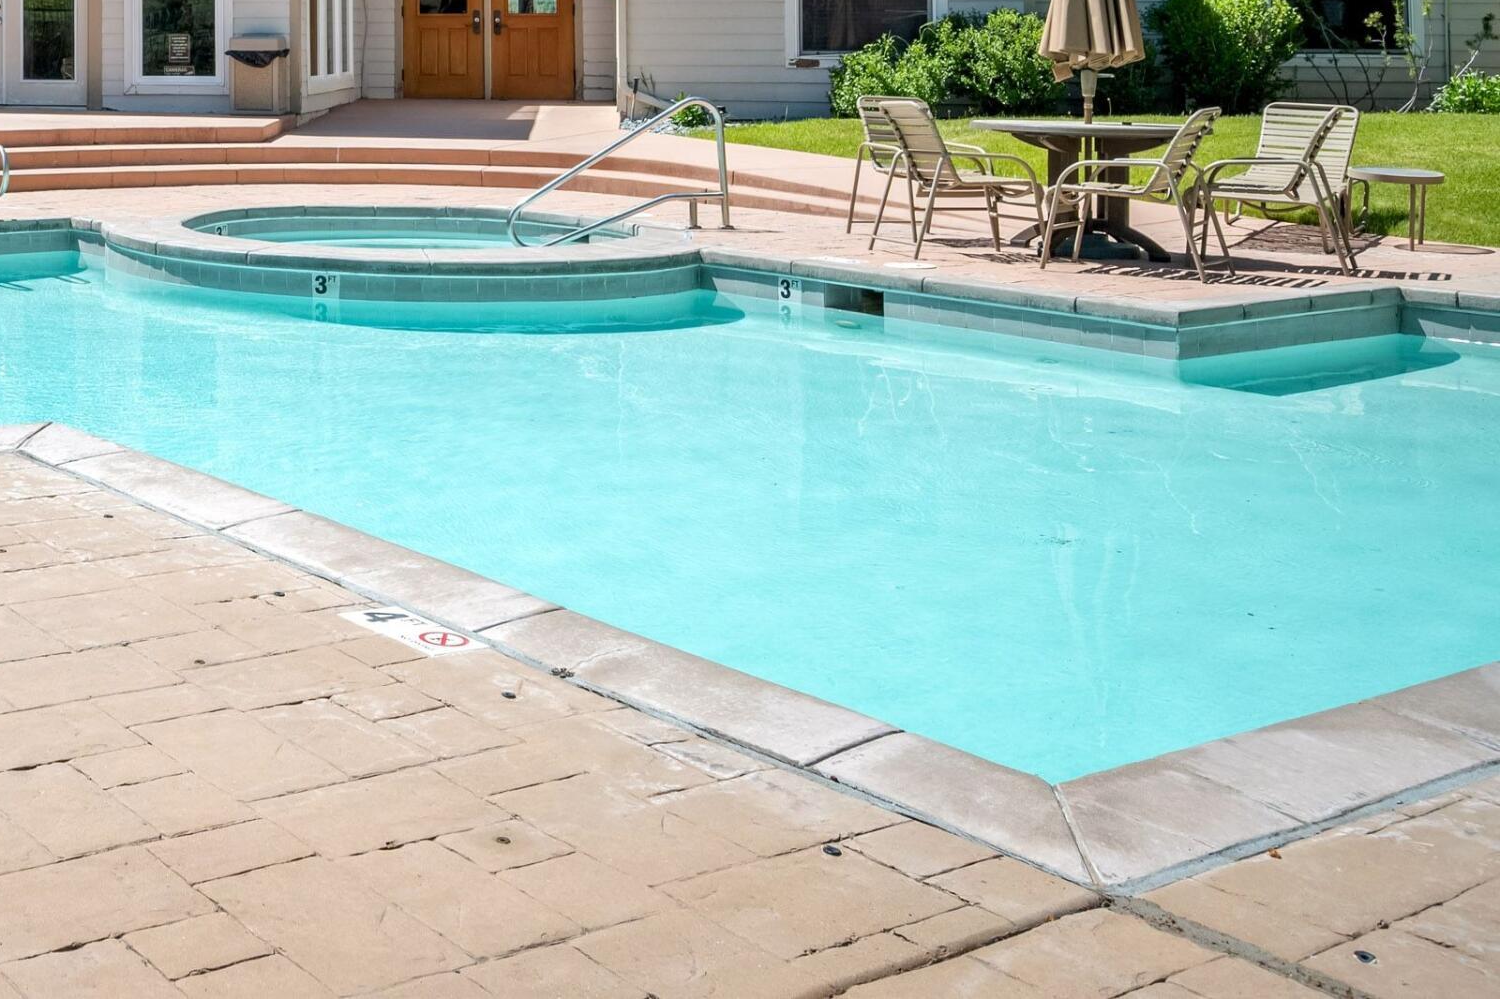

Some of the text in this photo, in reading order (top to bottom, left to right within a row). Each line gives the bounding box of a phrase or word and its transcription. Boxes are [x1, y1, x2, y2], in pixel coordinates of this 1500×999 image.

[315, 275, 336, 294] 3 FT
[781, 279, 799, 298] 3 FT
[364, 612, 408, 623] 4
